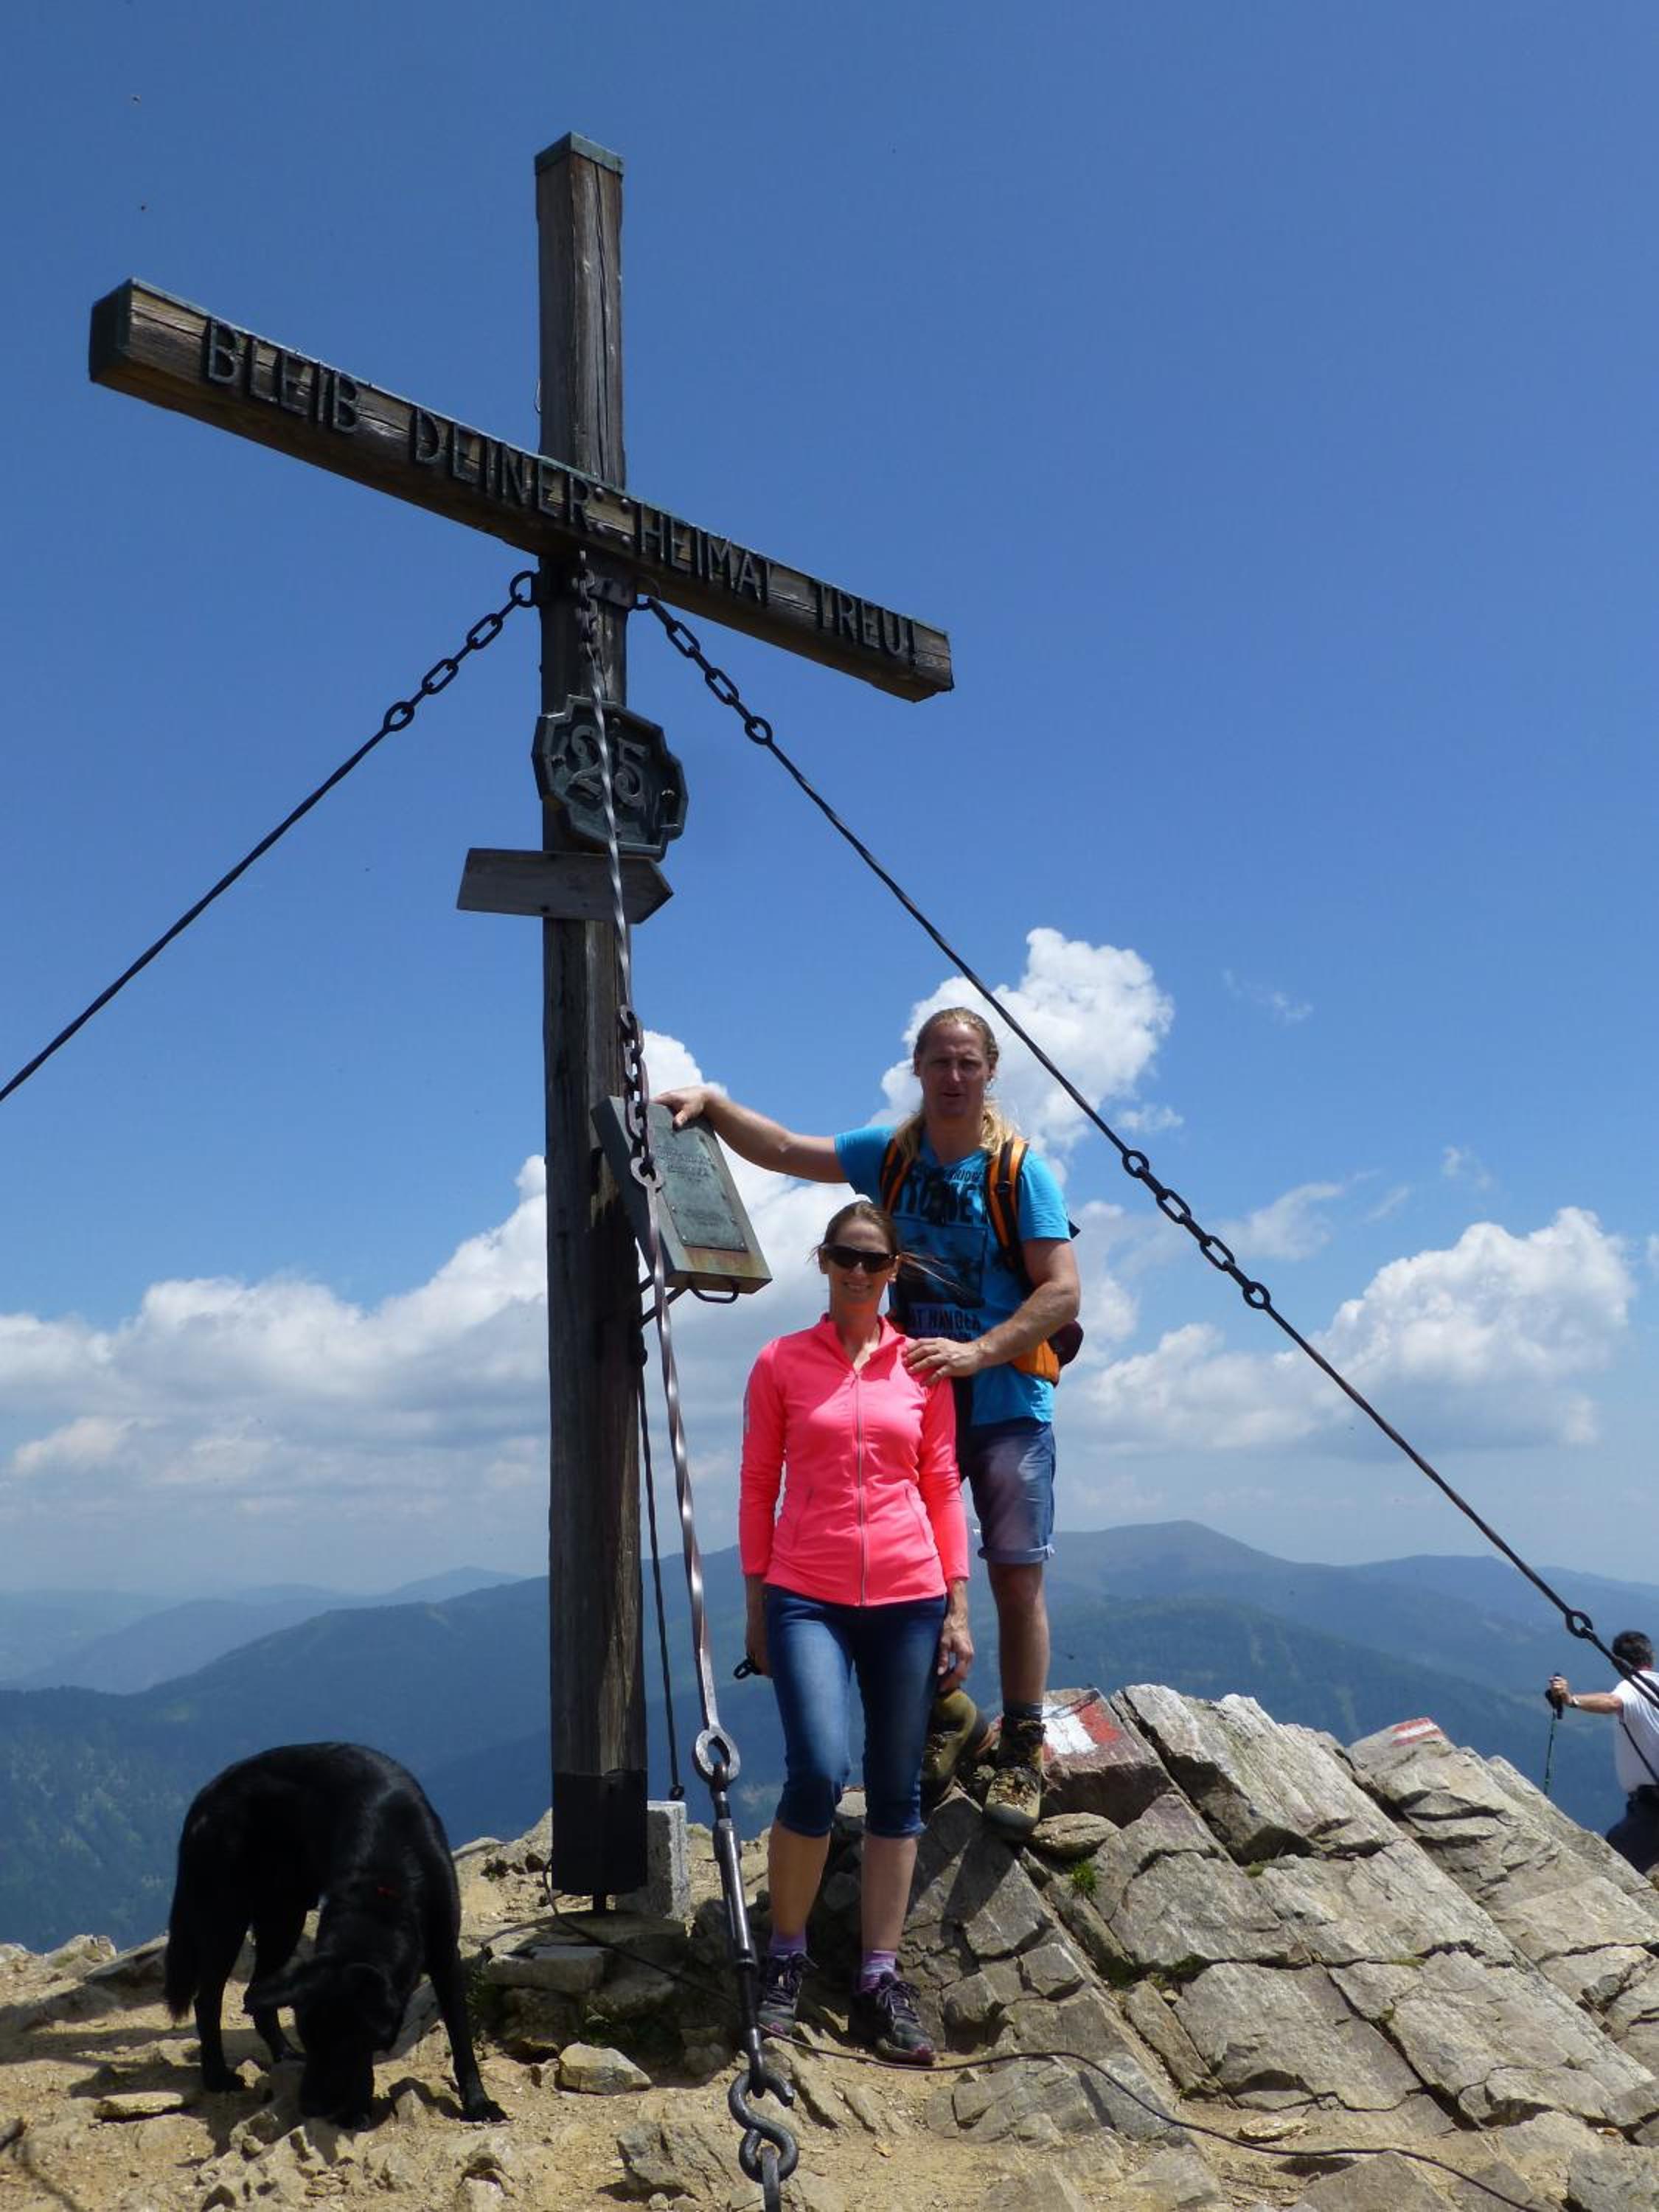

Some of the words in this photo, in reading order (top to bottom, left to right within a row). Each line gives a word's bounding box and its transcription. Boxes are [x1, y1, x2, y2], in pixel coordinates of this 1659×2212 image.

[207, 319, 360, 434] BLEIB
[413, 408, 591, 531] DEINER
[639, 503, 776, 602] HEIMAT
